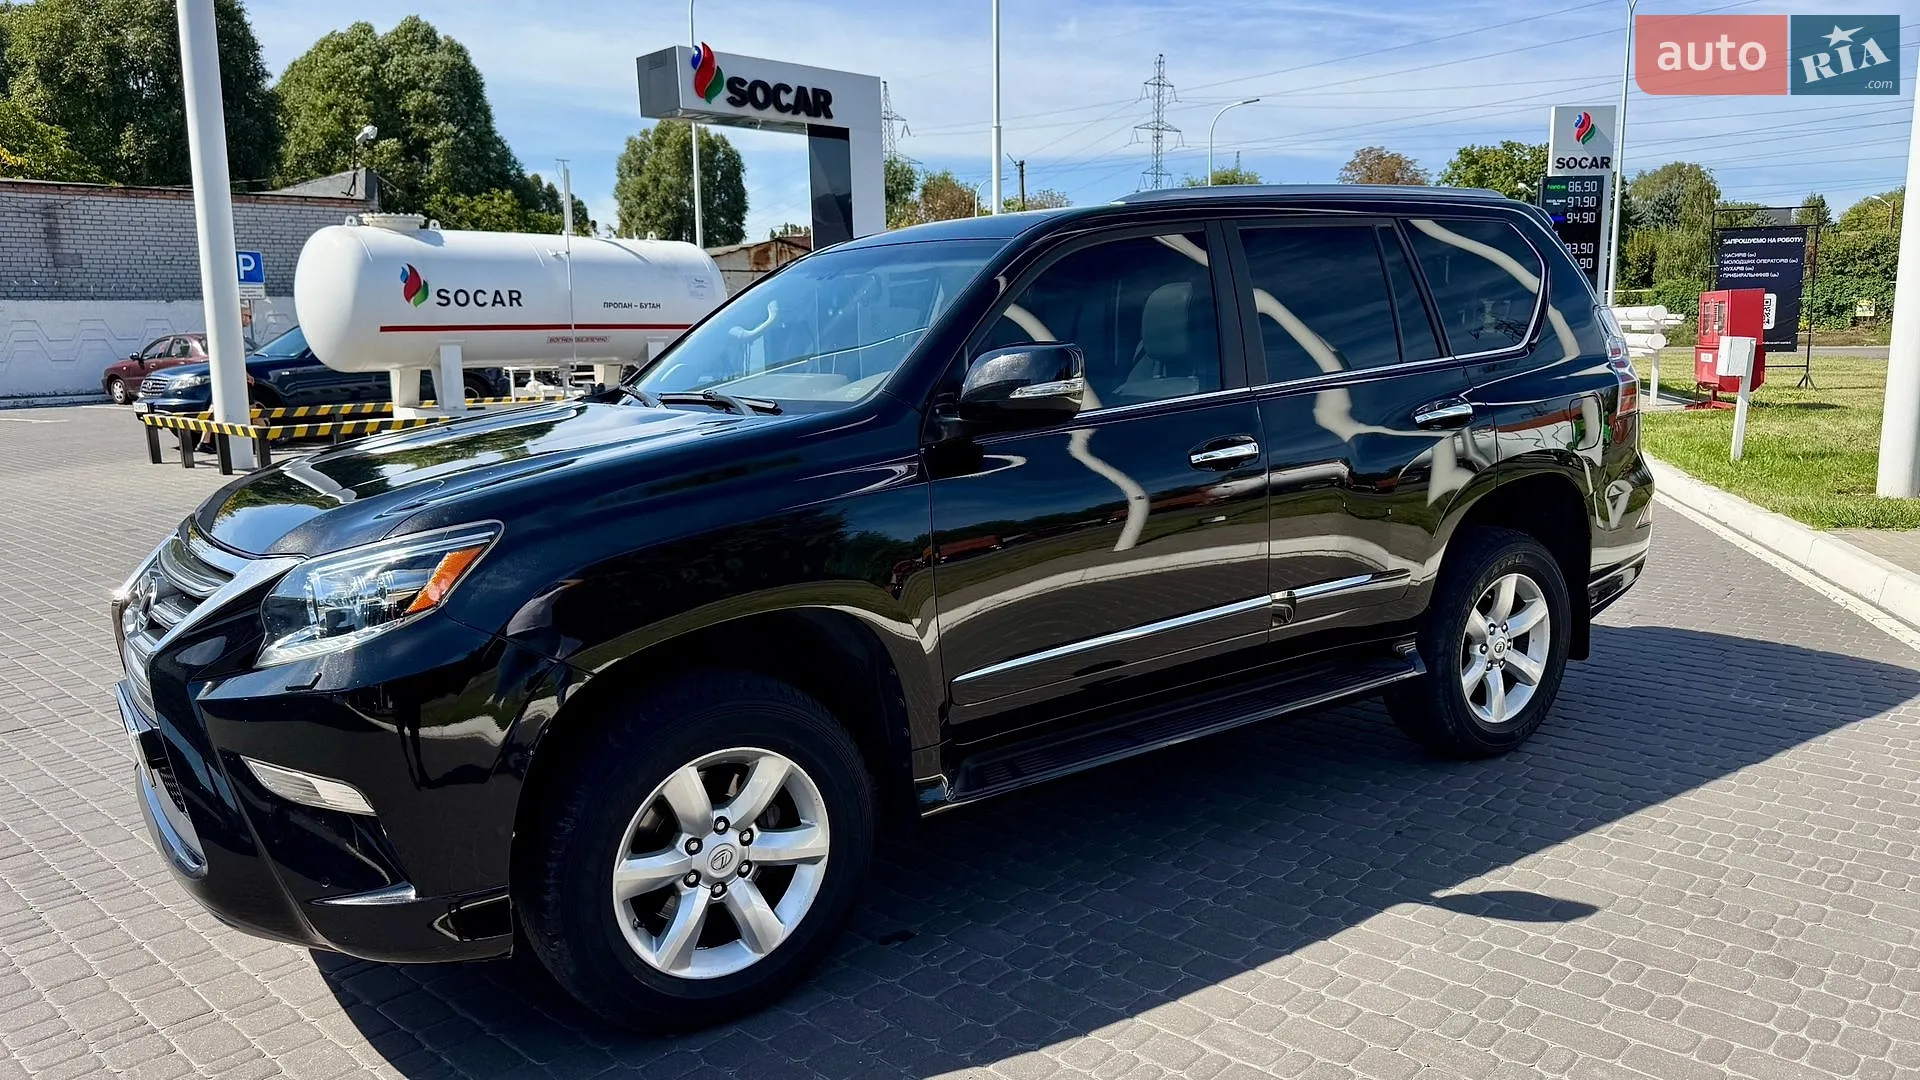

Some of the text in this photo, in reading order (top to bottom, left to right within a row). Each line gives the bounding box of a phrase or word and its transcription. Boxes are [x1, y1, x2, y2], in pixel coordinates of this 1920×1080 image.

[726, 76, 834, 119] SOCAR
[1555, 156, 1611, 169] SOCAR
[1568, 181, 1598, 192] 86.90
[1567, 196, 1597, 208] 97.90
[1566, 212, 1596, 223] 94.90
[238, 254, 256, 280] P
[436, 288, 523, 307] SOCAR
